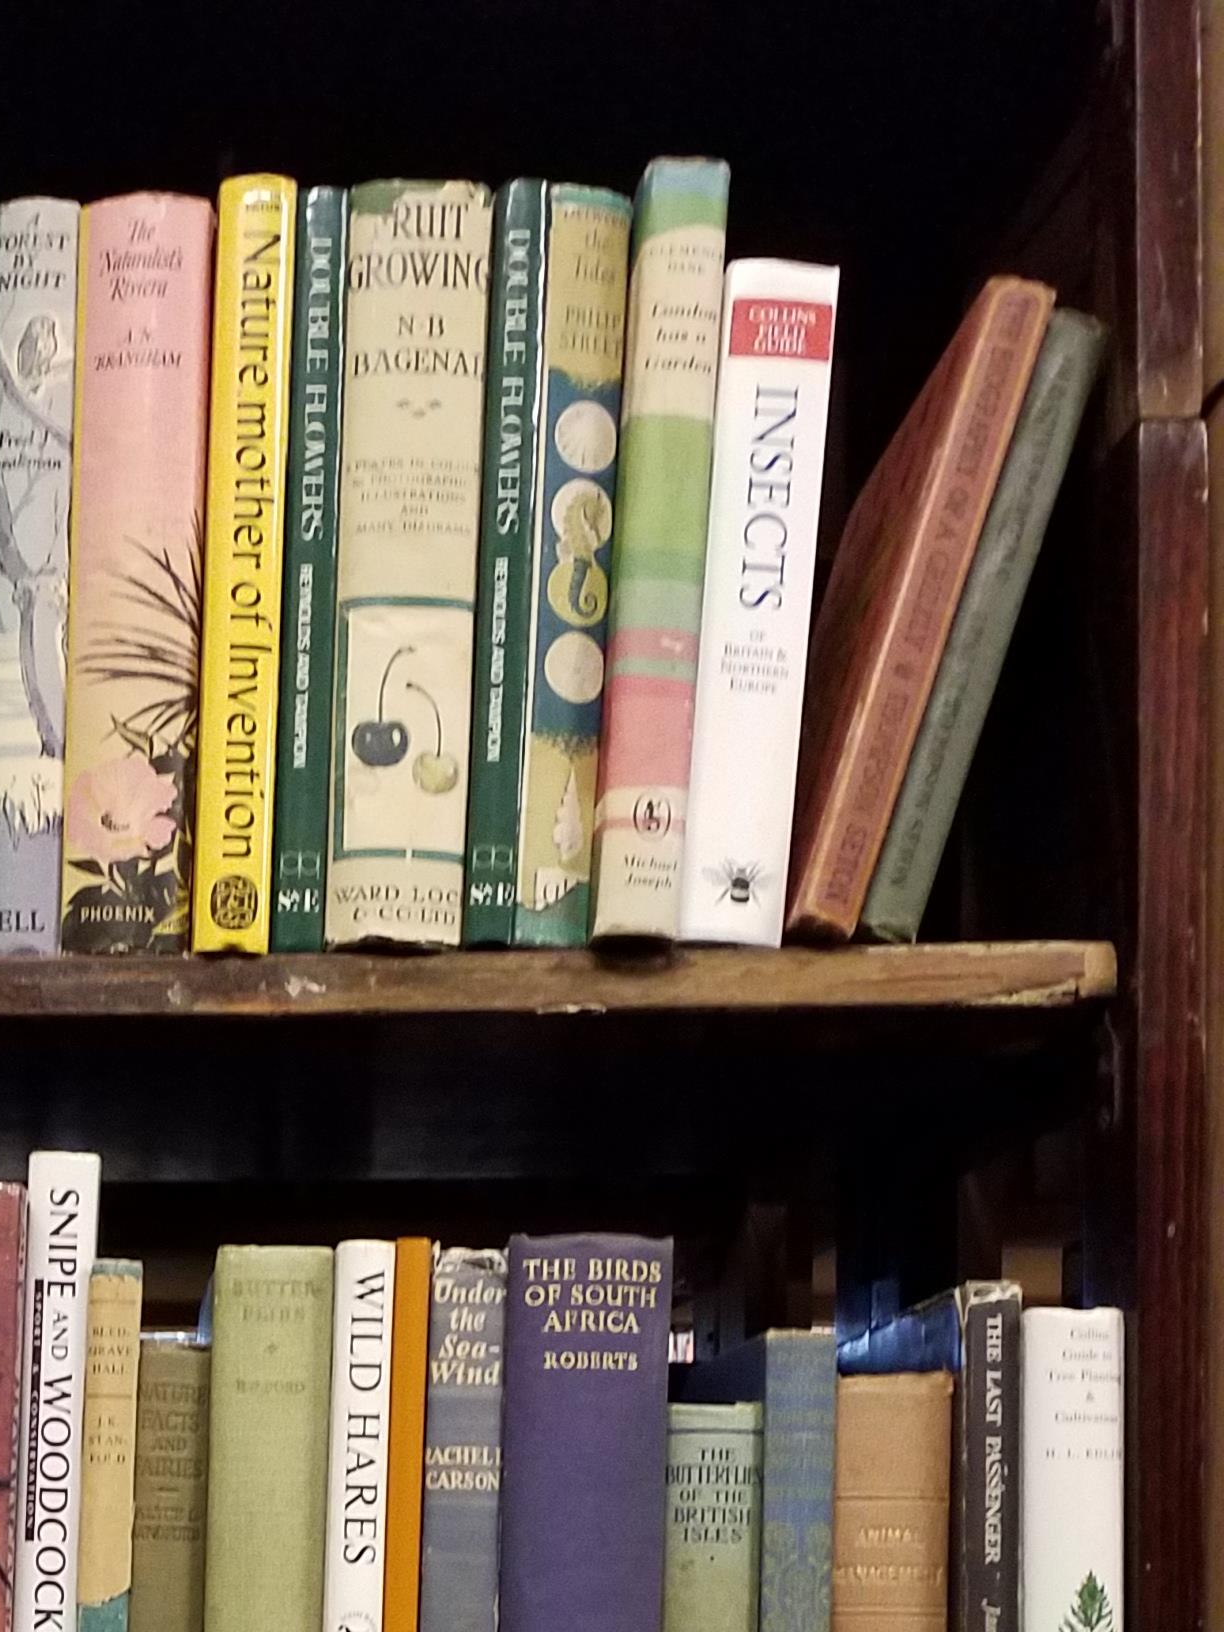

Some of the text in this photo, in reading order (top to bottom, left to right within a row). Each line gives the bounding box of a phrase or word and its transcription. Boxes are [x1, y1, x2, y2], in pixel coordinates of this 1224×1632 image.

[131, 220, 155, 242] The
[749, 307, 816, 325] COLLINS
[301, 238, 333, 542] DOUBLE FLOWERS
[495, 229, 531, 536] DOUBLE FLOWERS
[231, 404, 276, 571] mother
[739, 384, 800, 610] INSECTS
[230, 577, 273, 630] of
[220, 645, 272, 858] Invention
[80, 908, 155, 924] PHOENIX
[524, 1259, 661, 1282] THE BIRDS
[433, 1278, 507, 1304] Under
[525, 1285, 656, 1308] OF SOUTH
[347, 1271, 385, 1392] WILD
[449, 1310, 484, 1332] the
[542, 1311, 640, 1334] AFRICA
[431, 1362, 500, 1385] Wind
[544, 1352, 638, 1371] ROBERTS
[986, 1313, 1003, 1427] THE LAST
[32, 1187, 80, 1632] SNIPE AND WOODCOCK
[342, 1413, 381, 1567] HARES
[426, 1471, 500, 1491] CARSON
